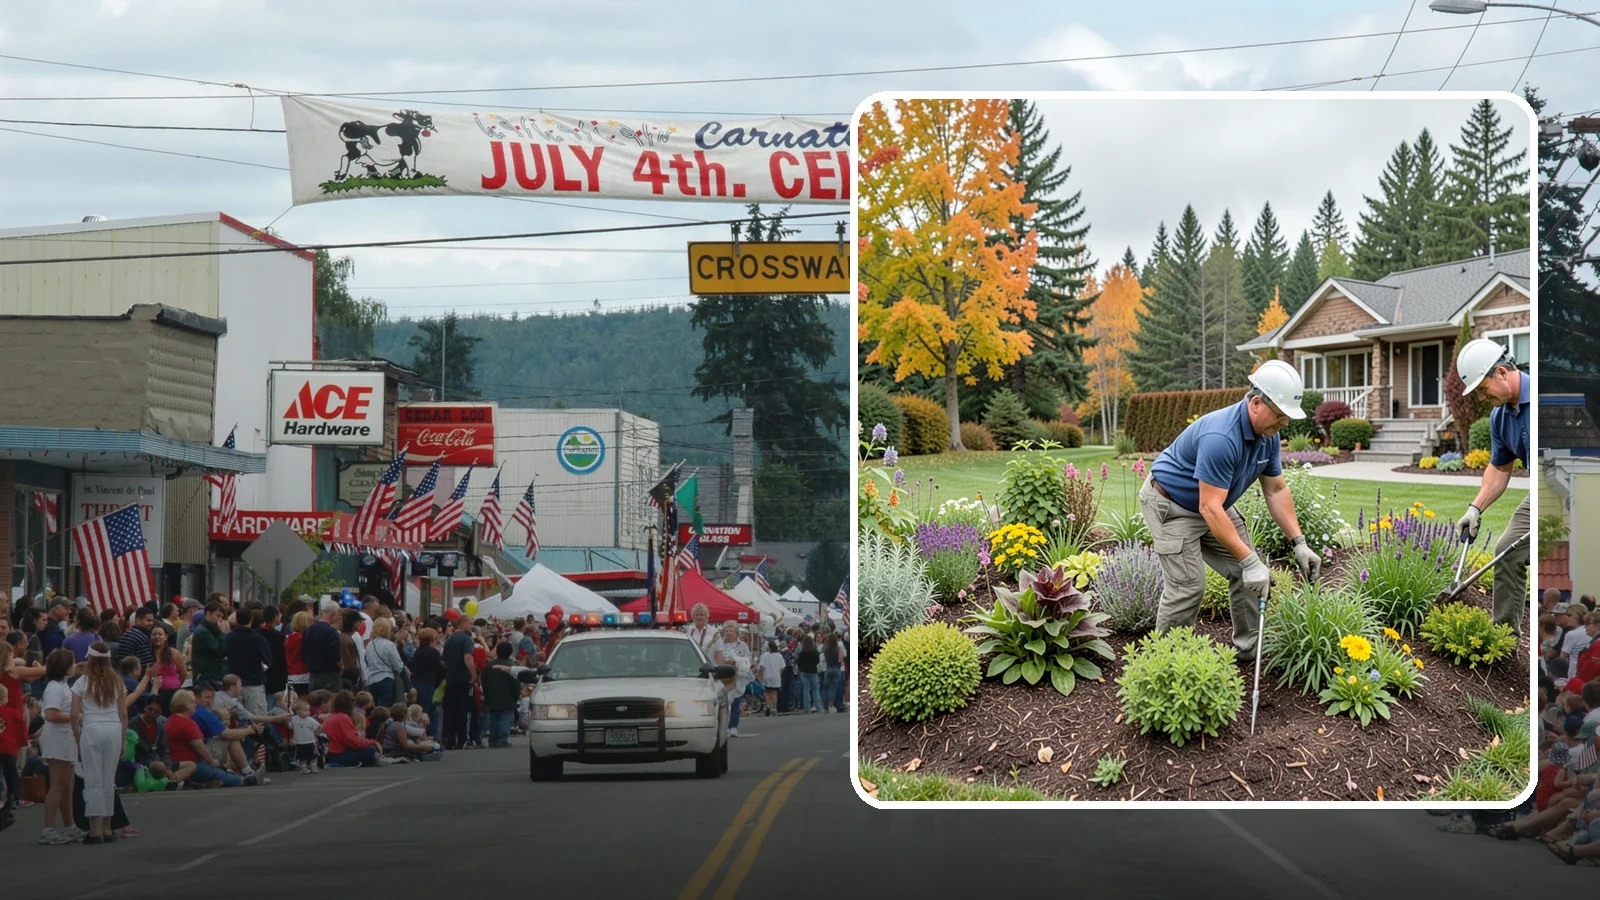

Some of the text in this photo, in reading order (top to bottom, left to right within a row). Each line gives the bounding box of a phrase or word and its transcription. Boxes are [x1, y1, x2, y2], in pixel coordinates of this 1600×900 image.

[481, 141, 605, 192] JULY
[632, 150, 747, 198] 4th.
[696, 254, 851, 280] CROSSWA
[282, 380, 373, 420] ACE
[405, 409, 453, 422] CEDAR
[283, 421, 371, 436] Hardware
[416, 428, 477, 447] Coca-Cola
[83, 485, 155, 495] St. Vincent de Paul
[688, 527, 741, 535] CRNATION
[699, 535, 730, 543] GLASS
